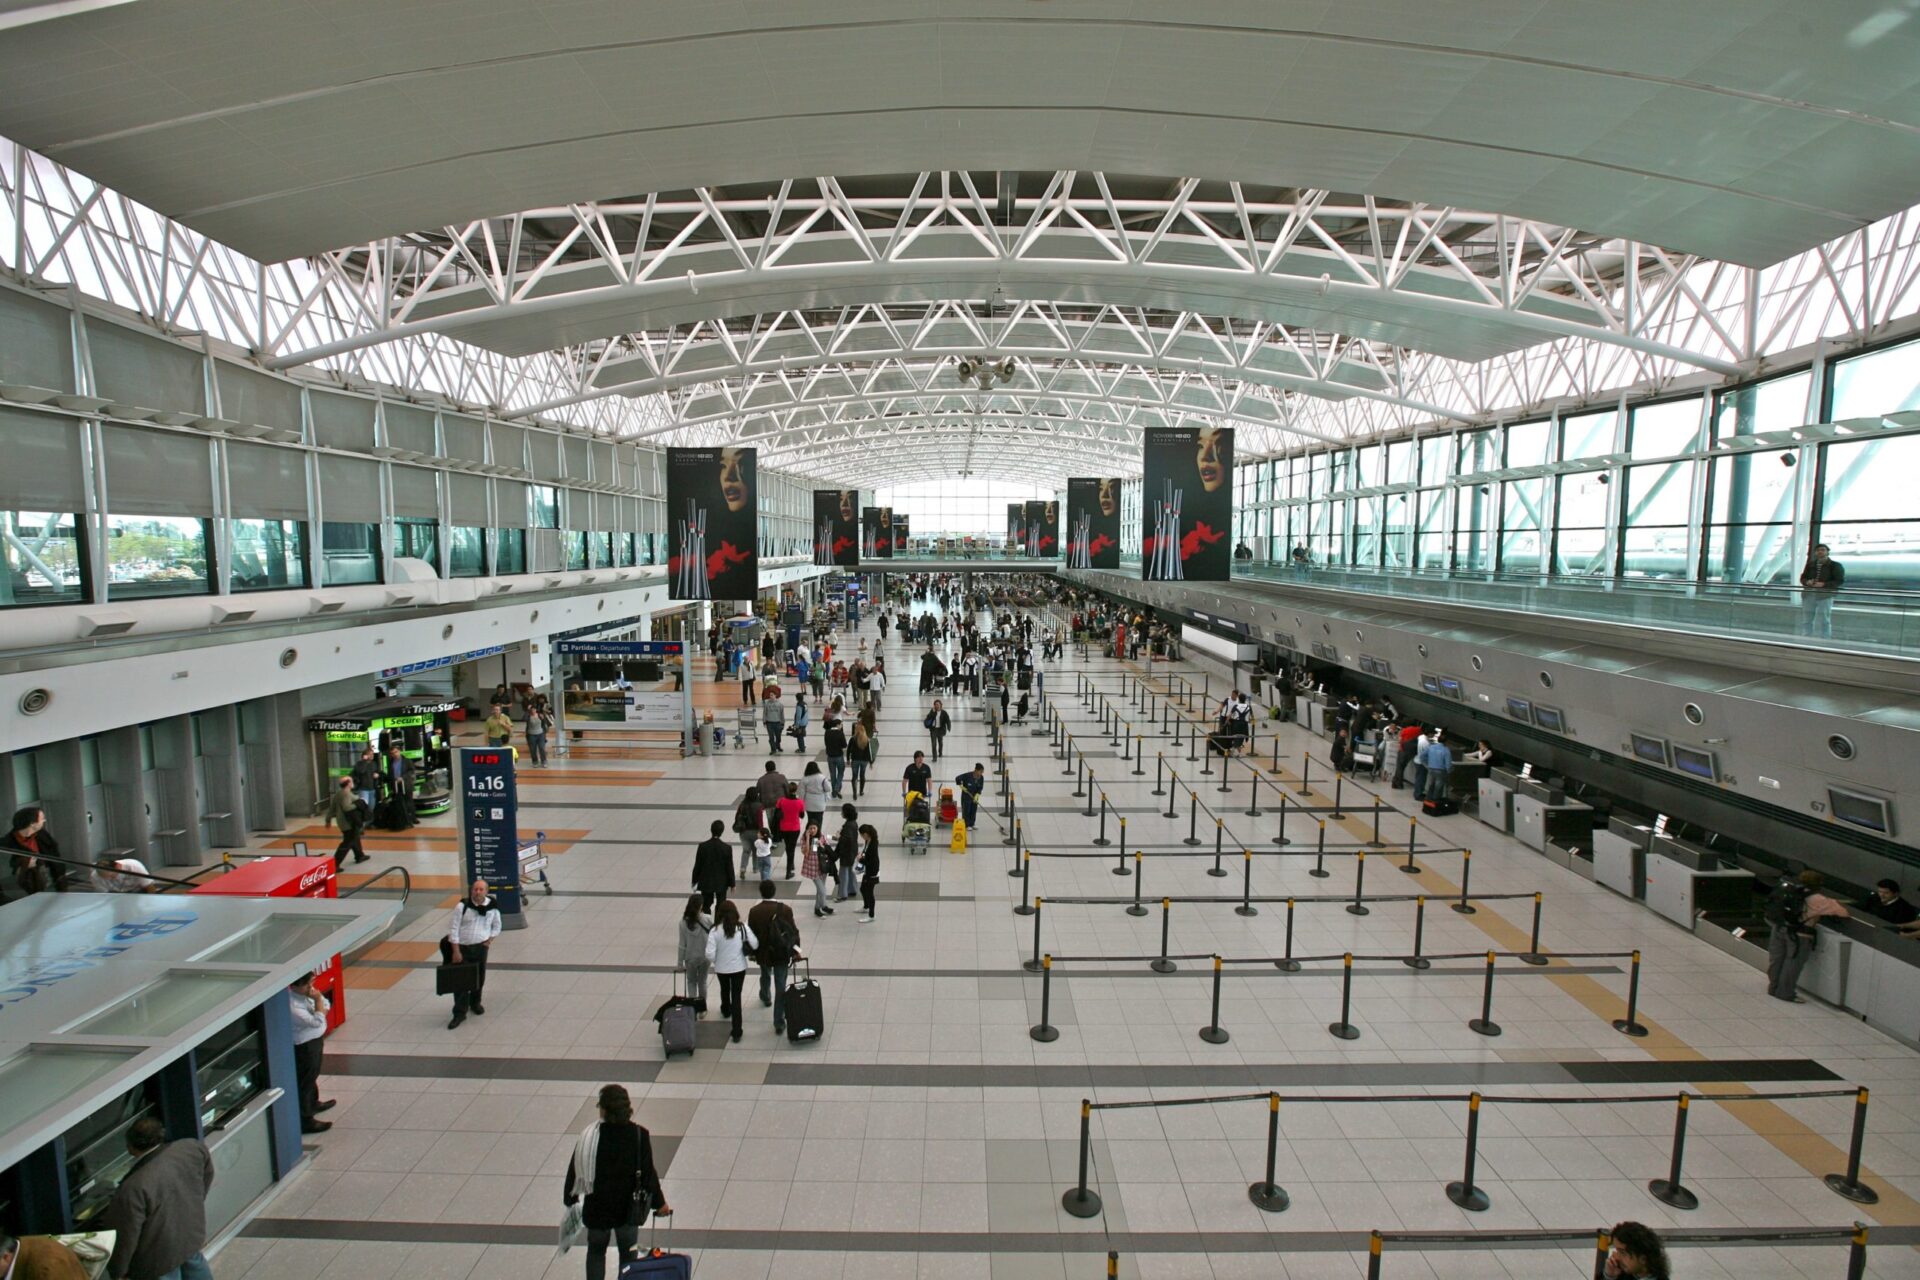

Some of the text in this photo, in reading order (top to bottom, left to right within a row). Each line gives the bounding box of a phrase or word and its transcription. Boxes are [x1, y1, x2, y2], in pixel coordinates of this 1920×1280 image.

[413, 703, 456, 714] TrueStar
[318, 720, 363, 731] TrueStar
[390, 716, 421, 725] Secure
[327, 732, 366, 741] SecureBag
[1724, 774, 1737, 785] 66
[1811, 800, 1825, 813] 67
